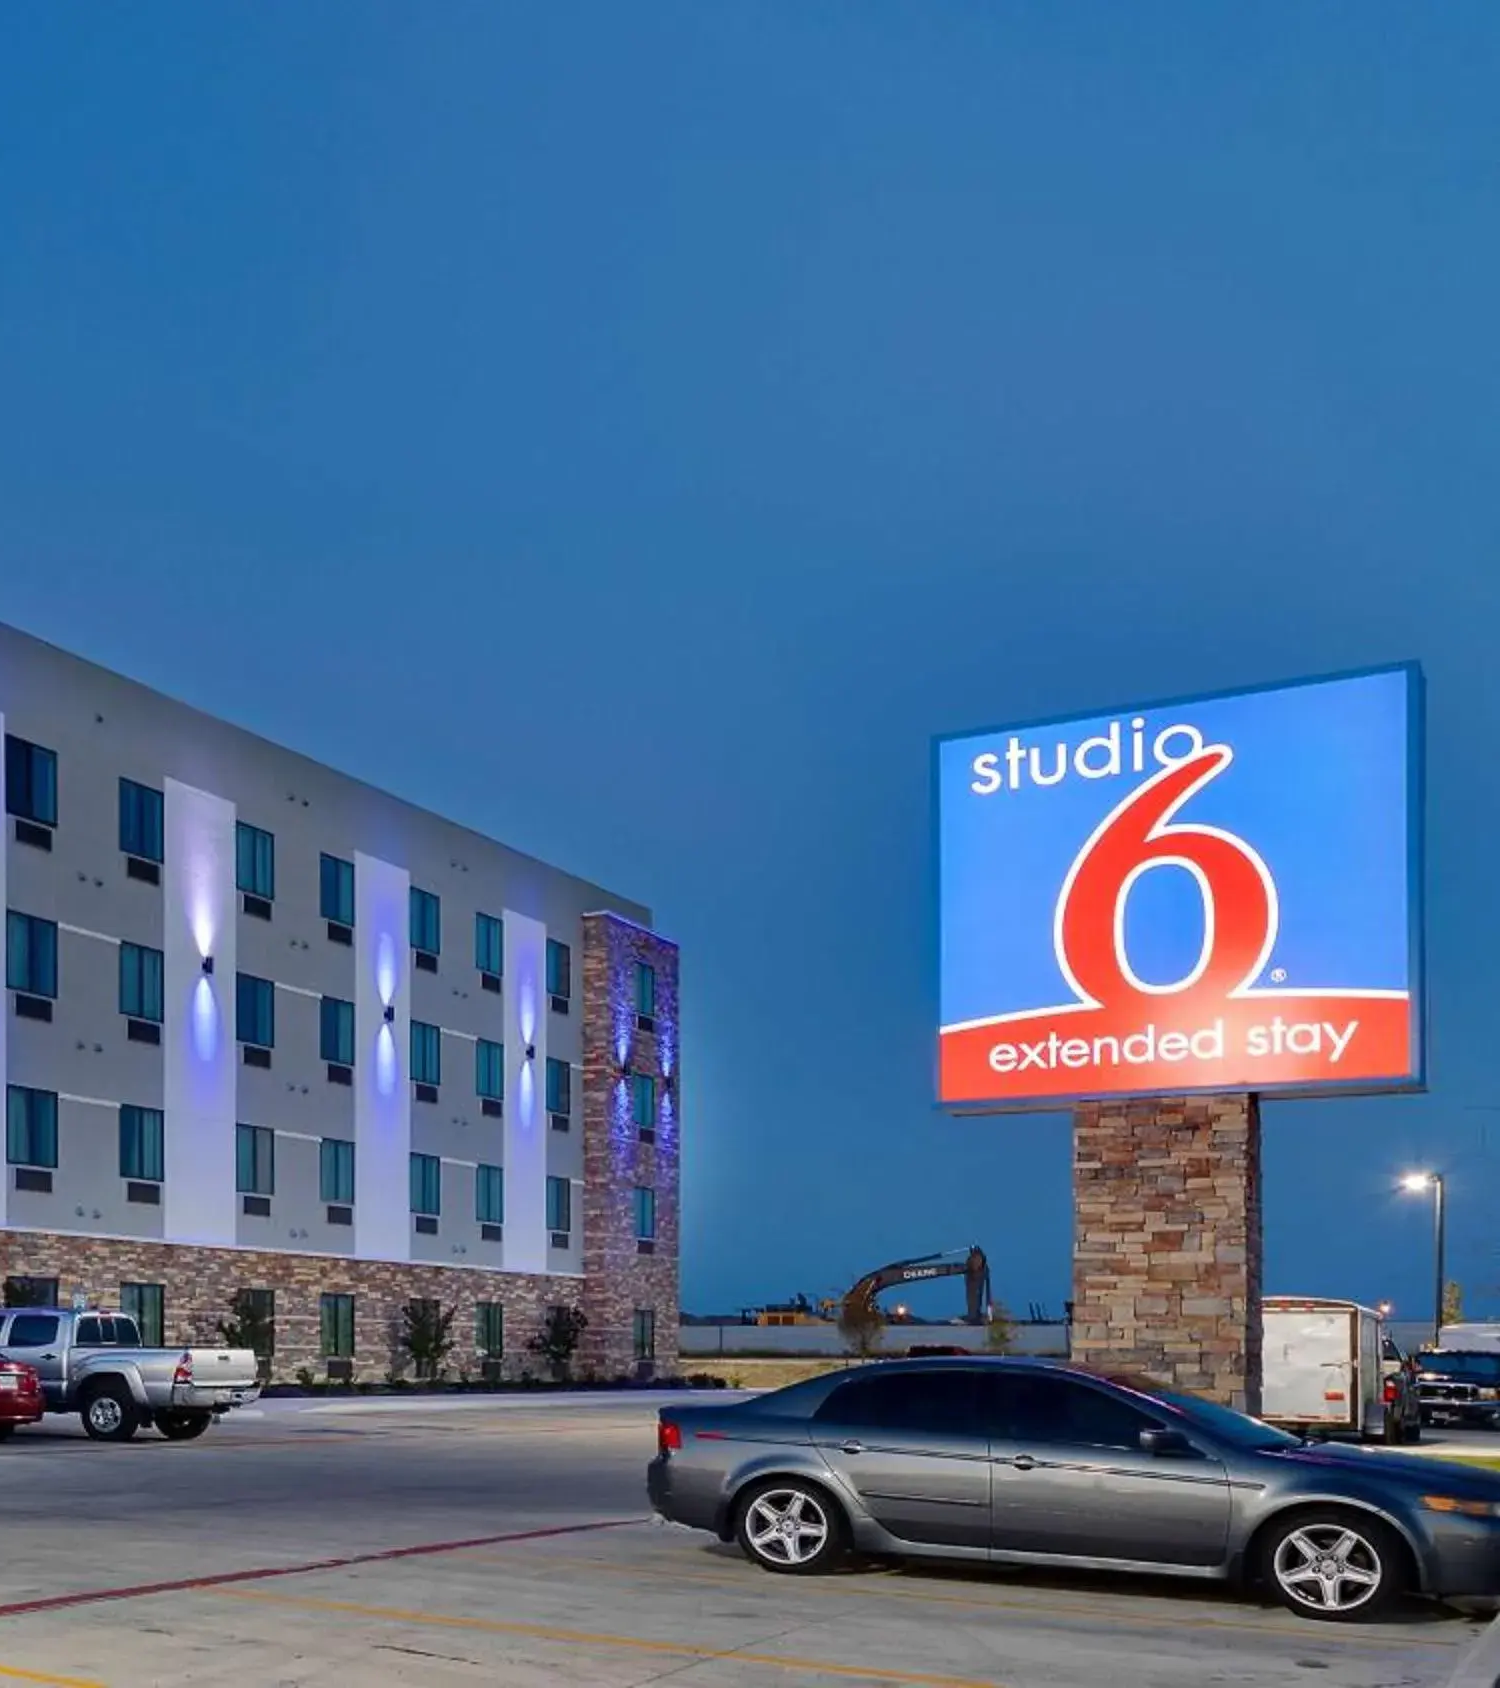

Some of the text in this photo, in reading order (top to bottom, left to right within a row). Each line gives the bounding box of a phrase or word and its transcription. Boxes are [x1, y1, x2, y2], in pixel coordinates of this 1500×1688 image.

[970, 717, 1204, 795] studio
[1053, 743, 1279, 1008] 6
[988, 1015, 1360, 1073] extended stay
